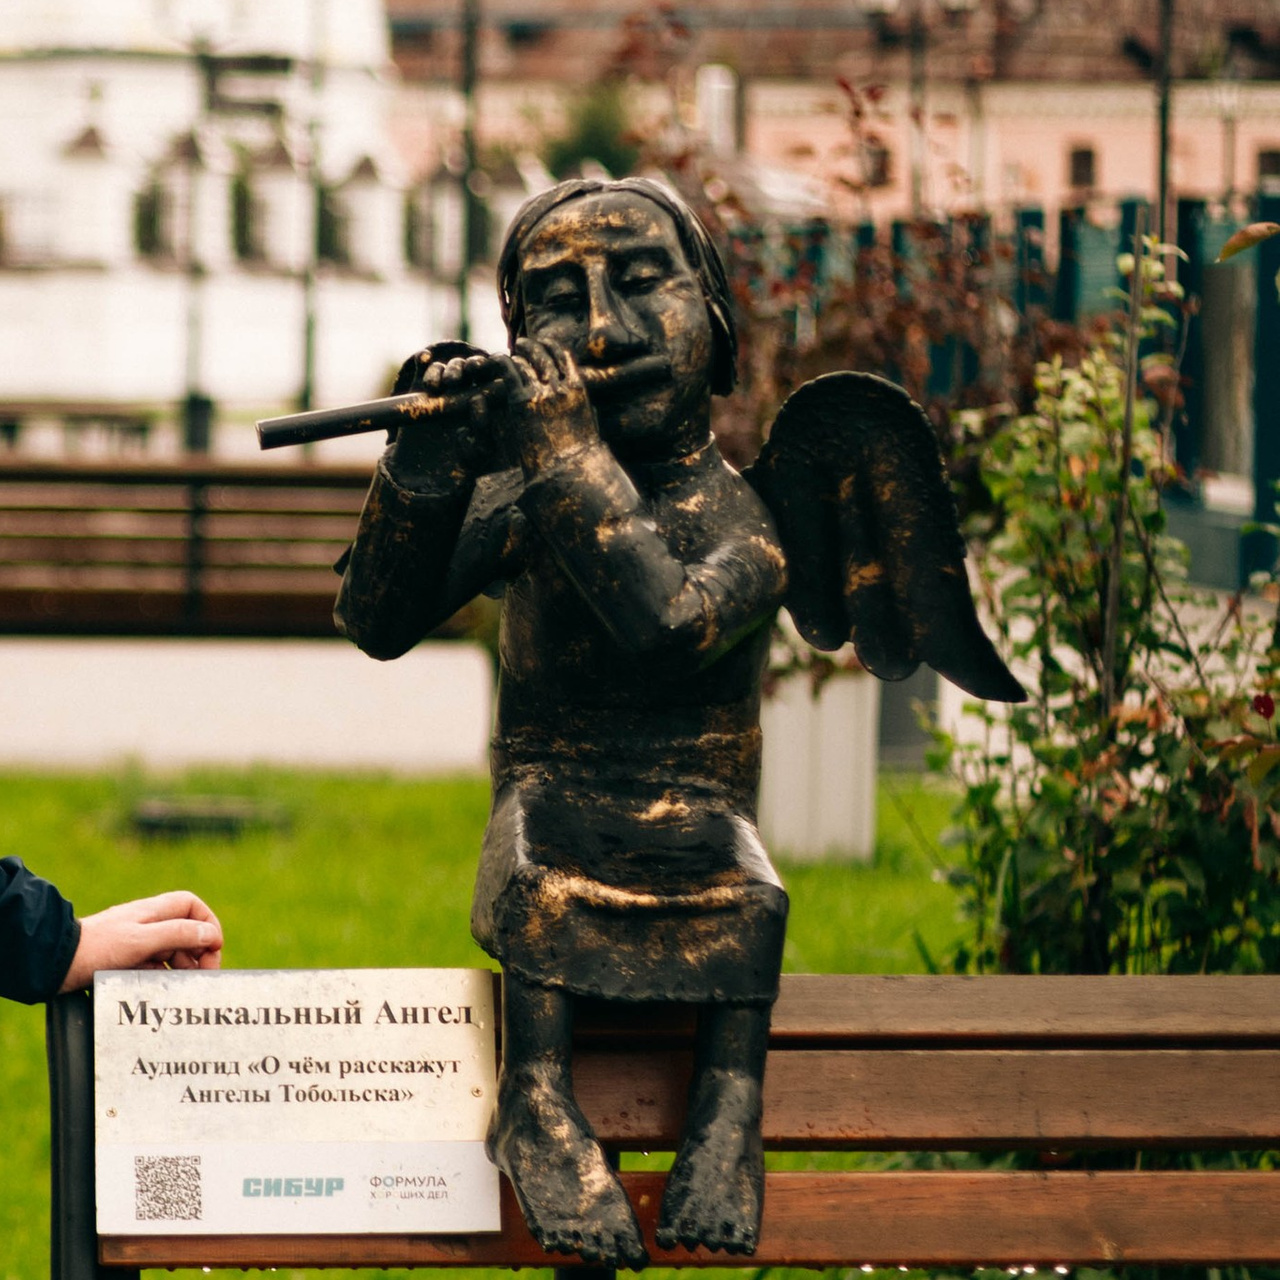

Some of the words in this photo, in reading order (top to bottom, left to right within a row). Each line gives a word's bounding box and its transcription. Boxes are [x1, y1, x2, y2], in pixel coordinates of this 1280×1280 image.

[118, 999, 362, 1032] Музыкальный
[375, 1000, 472, 1025] Ангел
[131, 1057, 240, 1080] Аудиогид
[247, 1055, 280, 1075] «О
[288, 1056, 330, 1075] чём
[338, 1059, 461, 1079] расскажут
[180, 1084, 270, 1104] Ангелы
[278, 1084, 414, 1104] Тобольска»
[242, 1178, 344, 1197] СИБУР
[369, 1175, 448, 1188] ФОРМУЛА
[426, 1190, 449, 1200] ДЕЛ
